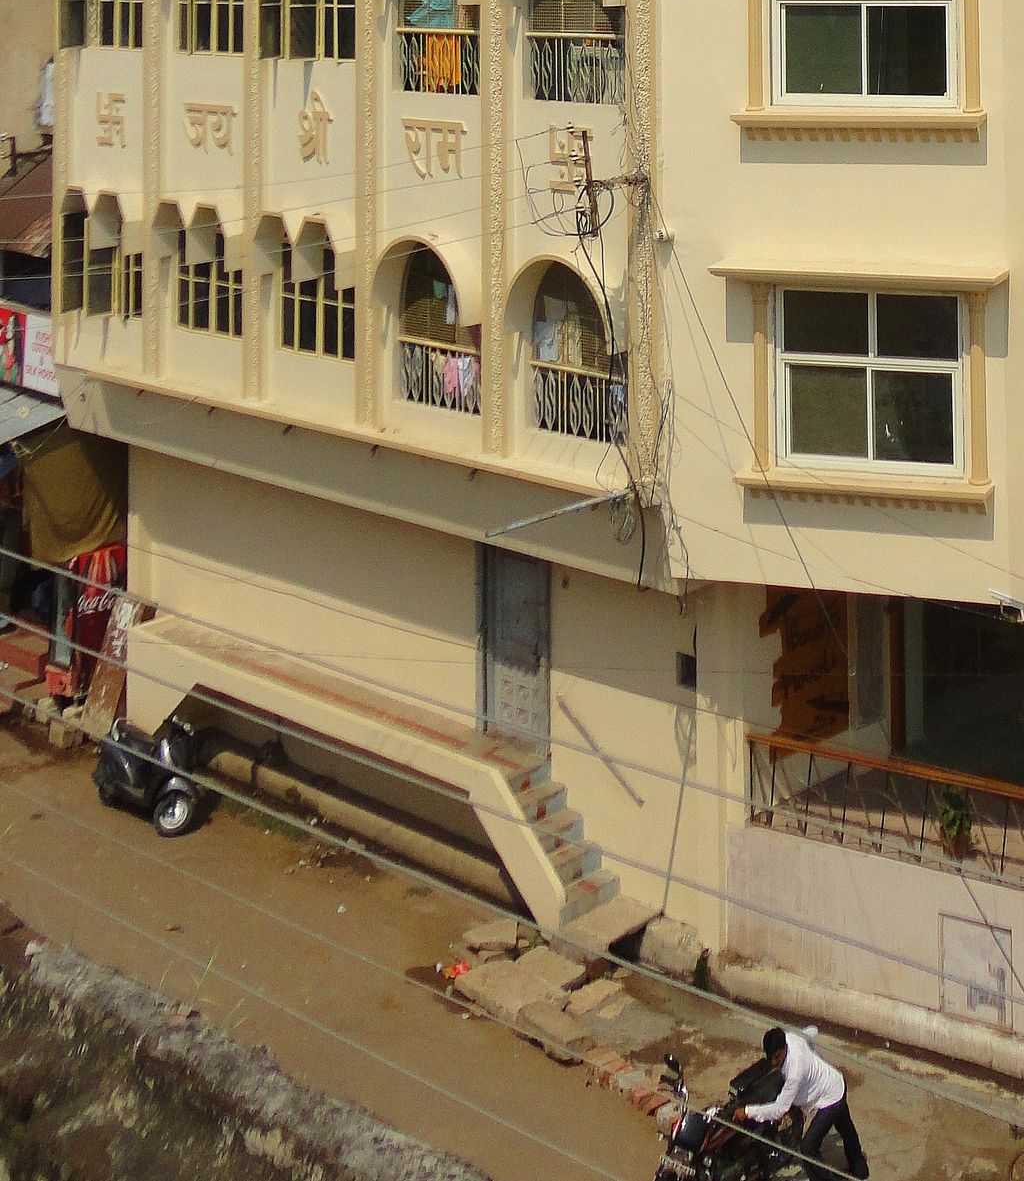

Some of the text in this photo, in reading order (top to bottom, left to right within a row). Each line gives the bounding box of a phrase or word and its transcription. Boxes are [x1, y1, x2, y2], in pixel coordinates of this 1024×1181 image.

[183, 89, 467, 180] जय श्री राम
